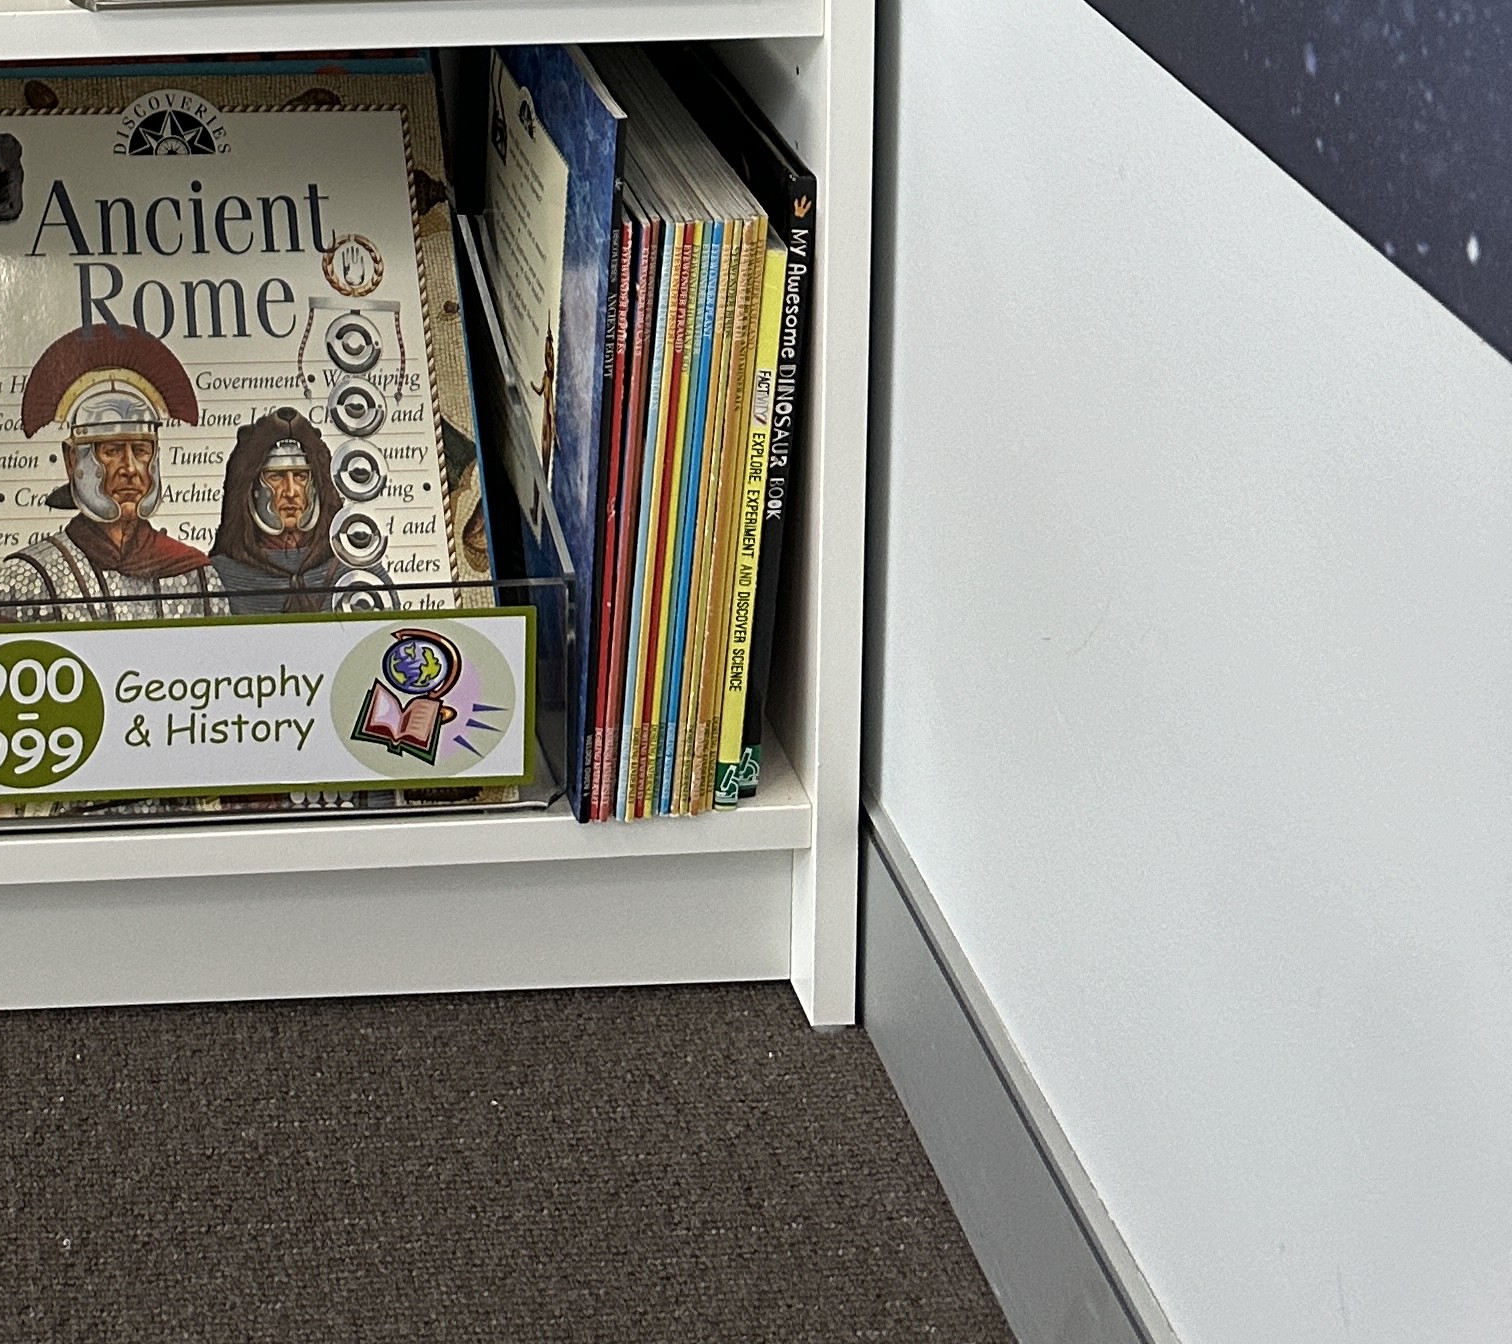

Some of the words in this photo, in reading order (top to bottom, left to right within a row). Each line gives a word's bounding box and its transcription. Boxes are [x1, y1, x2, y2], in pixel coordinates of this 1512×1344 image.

[113, 93, 232, 155] DISCOVERIES
[24, 178, 336, 257] Ancient
[73, 261, 297, 340] Rome
[604, 292, 617, 339] ANCIENT
[781, 263, 807, 359] Awesome
[195, 370, 302, 390] Government
[603, 342, 616, 379] EGYPT
[390, 403, 424, 423] and
[769, 364, 797, 469] DINOSAUR
[169, 446, 224, 465] Tunics
[765, 477, 785, 520] BOOK
[402, 514, 436, 535] and
[741, 489, 760, 559] EXPERIMENT
[738, 564, 753, 587] AND
[733, 591, 752, 644] DISCOVER
[114, 664, 324, 710] Geography
[728, 648, 745, 692] SCIENCE
[124, 713, 151, 747] &
[166, 714, 315, 751] History
